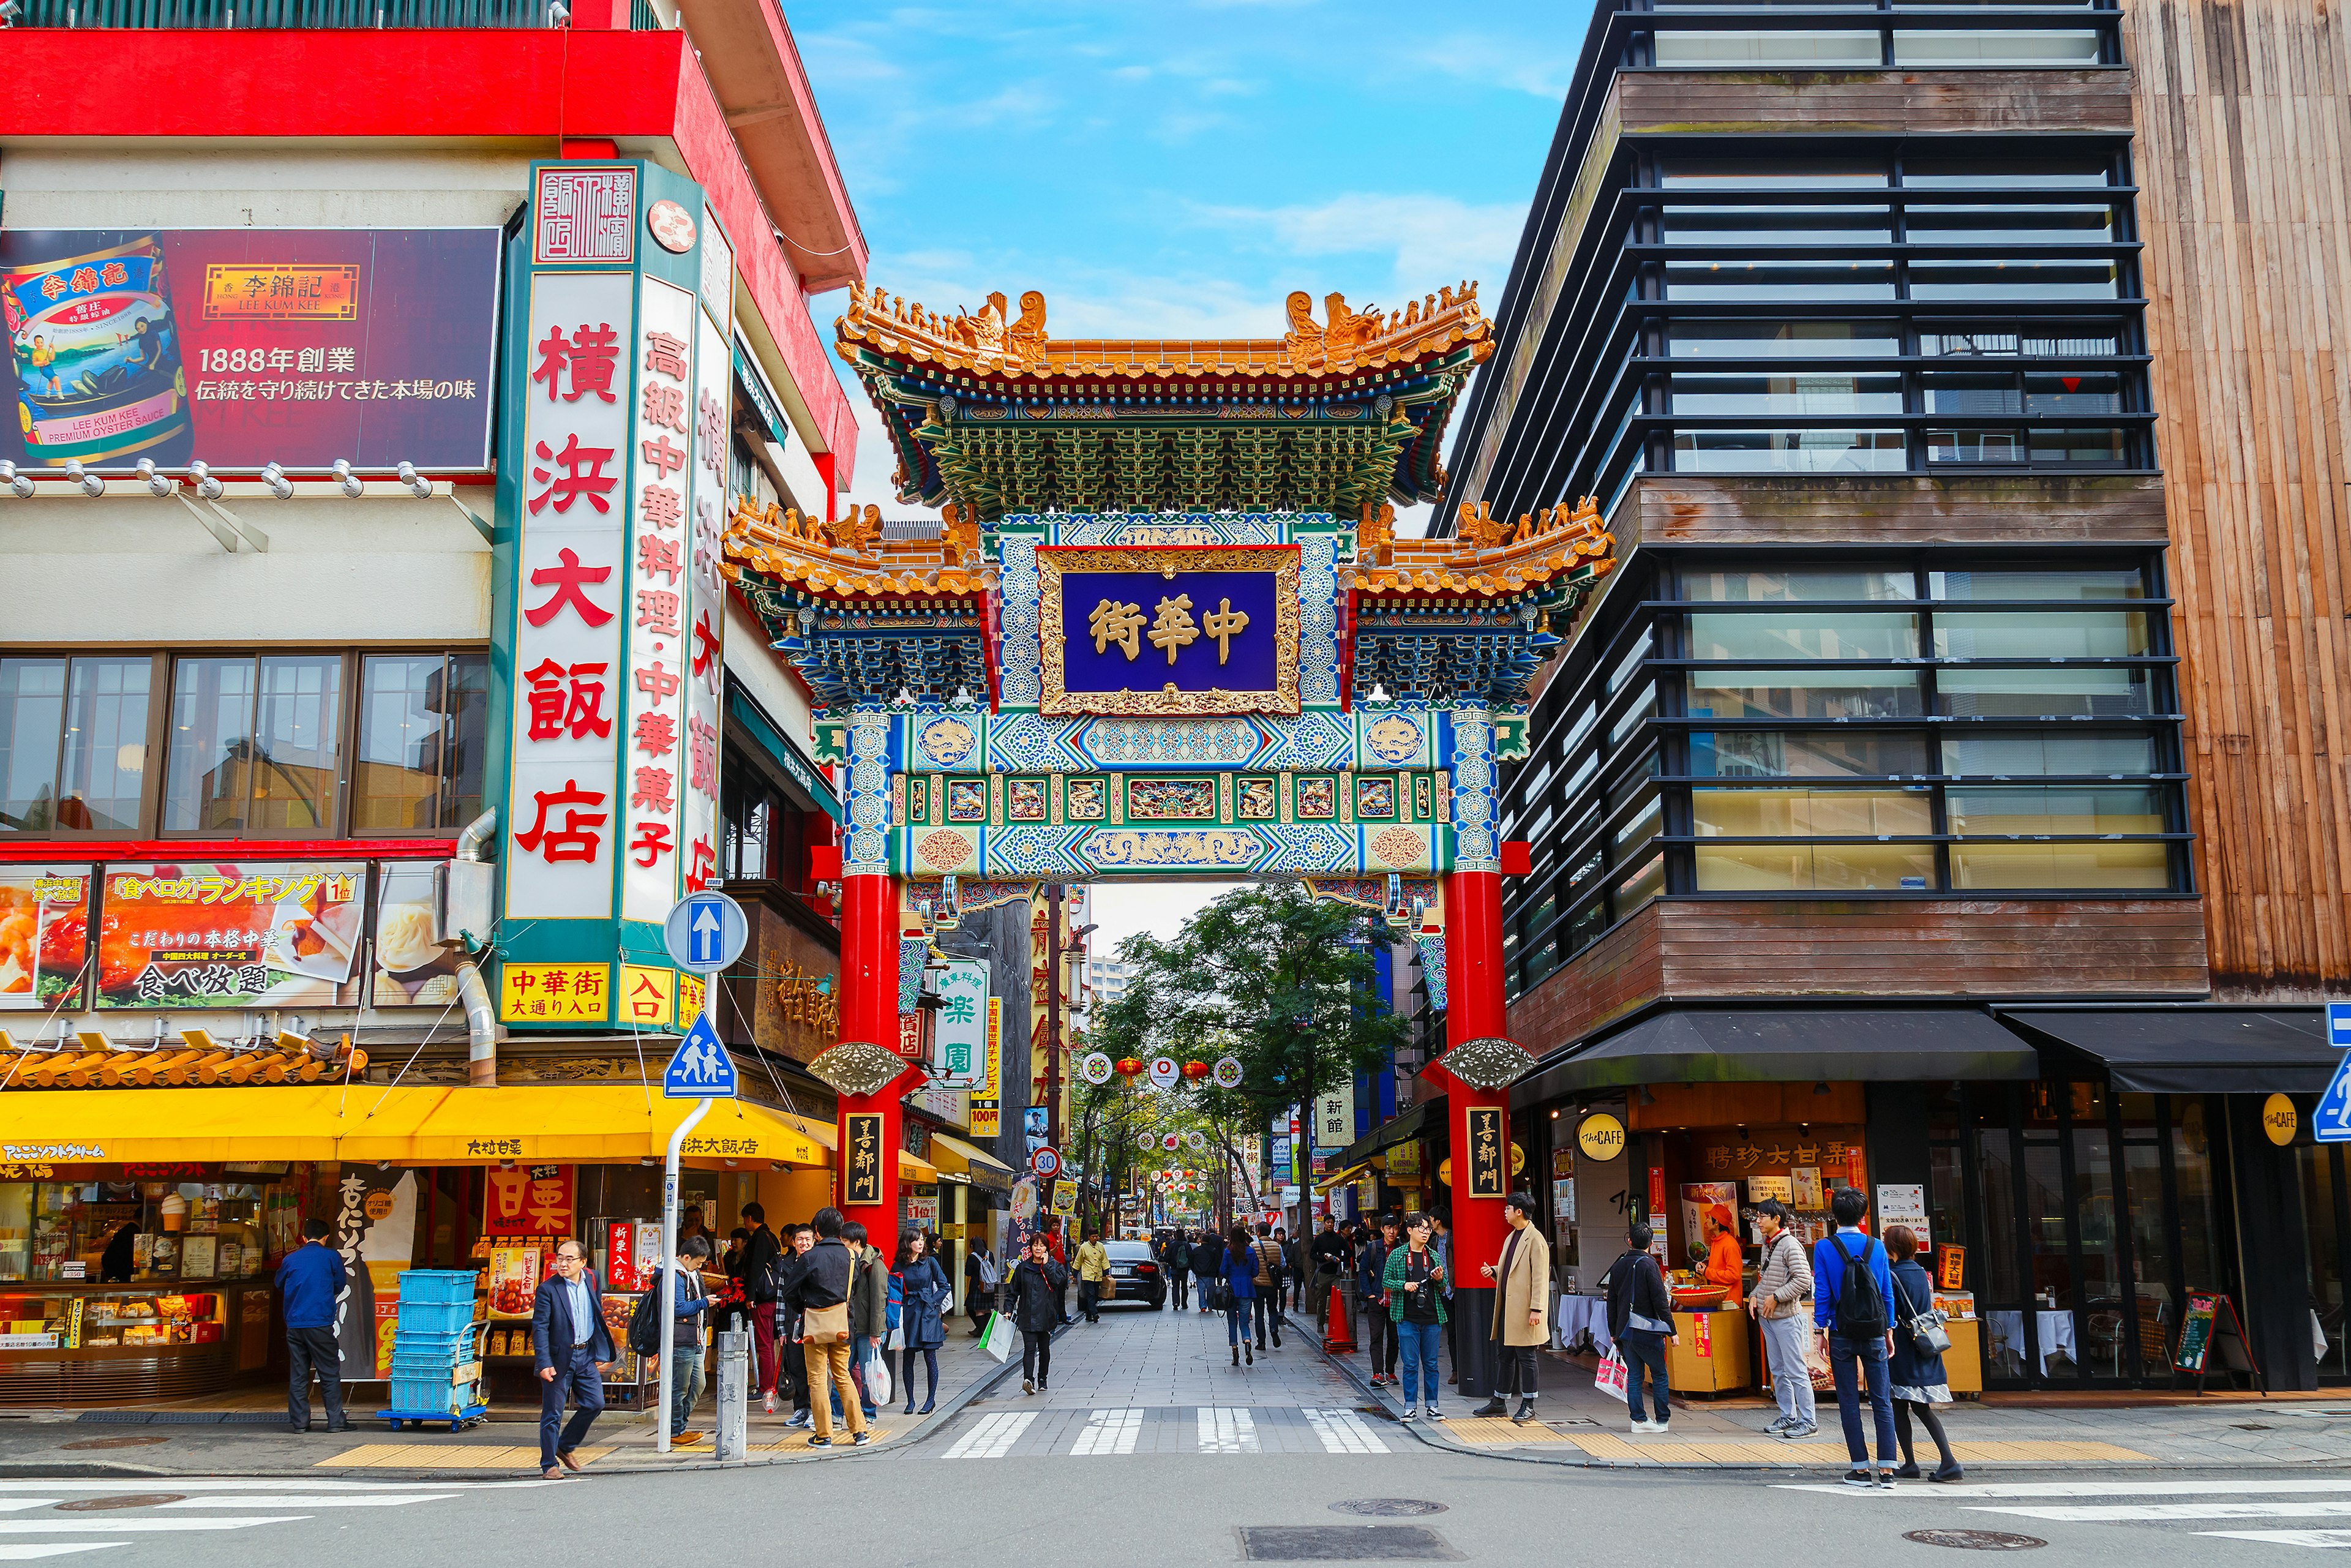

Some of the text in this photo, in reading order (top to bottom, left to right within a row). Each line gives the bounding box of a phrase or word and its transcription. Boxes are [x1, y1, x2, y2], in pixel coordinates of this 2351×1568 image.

[41, 263, 129, 300] 李錦記
[223, 282, 233, 292] 香
[242, 275, 322, 298] 李錦記
[239, 301, 321, 310] LEE KUM KEE
[198, 347, 356, 373] 1888年創業
[195, 379, 477, 401] 伝統を守り続けてきた本場の味
[49, 408, 165, 443] PREMIUM OYSTER SAUCE
[72, 408, 139, 431] LEE KUM KEE
[513, 322, 621, 865] 横浜大飯店
[33, 888, 80, 901] 食べ放題
[34, 878, 81, 888] 横浜中華街
[331, 885, 351, 900] 1位
[162, 952, 209, 961] 中国四大料理
[134, 966, 268, 997] 食べ放題
[512, 970, 604, 997] 中華街
[630, 973, 666, 1018] 入口
[509, 999, 601, 1016] 大通り入口
[943, 994, 977, 1073] 楽園
[972, 1110, 999, 1122] 100円
[1326, 1100, 1343, 1133] 新館
[2265, 1111, 2295, 1128] The CAFE
[467, 1138, 522, 1157] 大粒甘栗
[1581, 1130, 1622, 1144] The CAFE
[1037, 1155, 1055, 1169] 30
[1246, 1139, 1259, 1164] お粥
[489, 1165, 572, 1235] 甘栗
[614, 1226, 628, 1280] 新栗入荷
[1694, 1321, 1706, 1356] 新栗入荷
